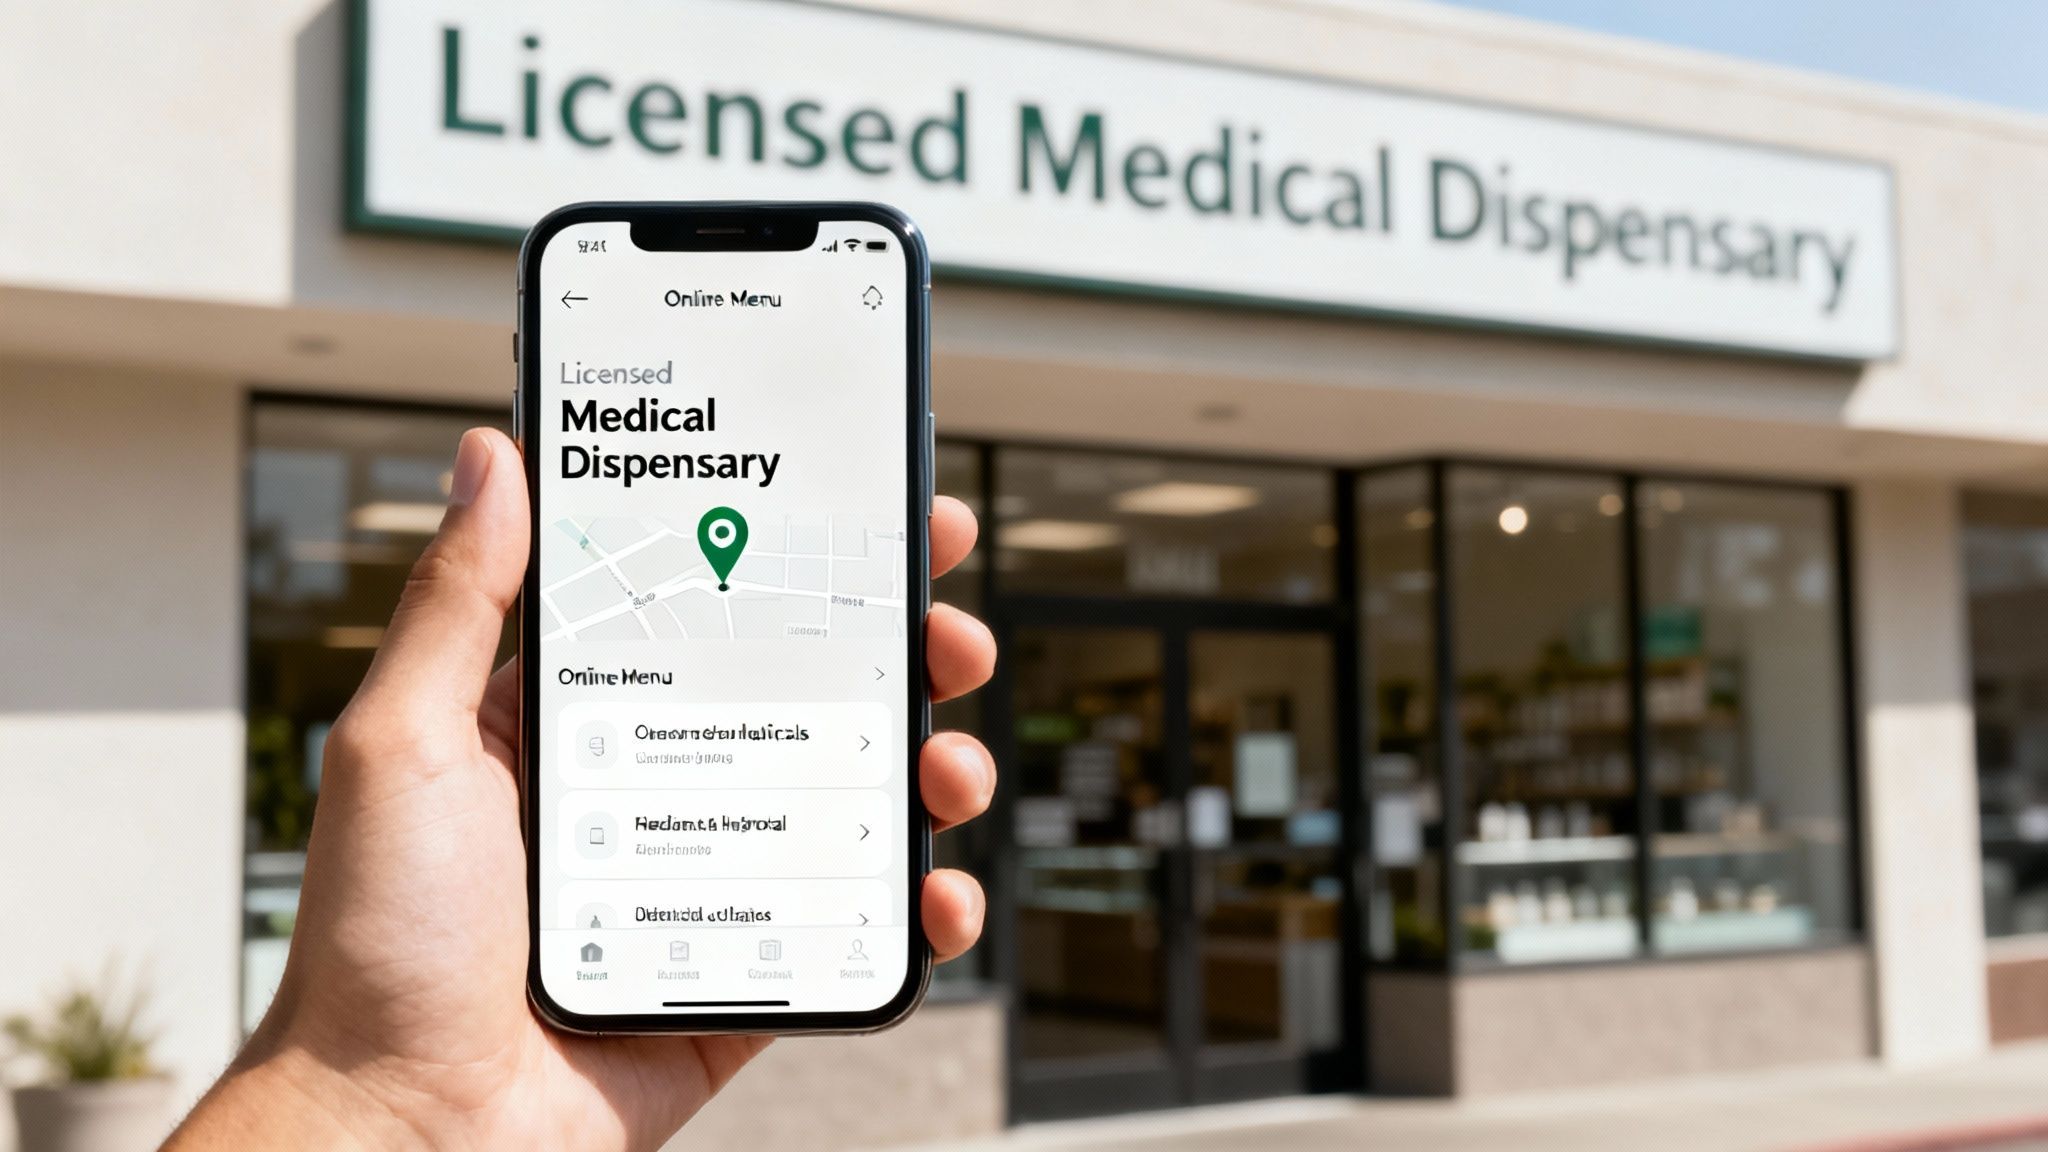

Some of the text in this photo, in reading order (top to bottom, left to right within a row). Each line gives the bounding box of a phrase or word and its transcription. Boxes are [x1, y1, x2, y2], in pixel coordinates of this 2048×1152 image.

[440, 26, 1861, 318] Licensed Medical Dispensary
[560, 360, 673, 385] Licensed
[561, 397, 716, 433] Medical
[561, 445, 781, 488] Dispensary
